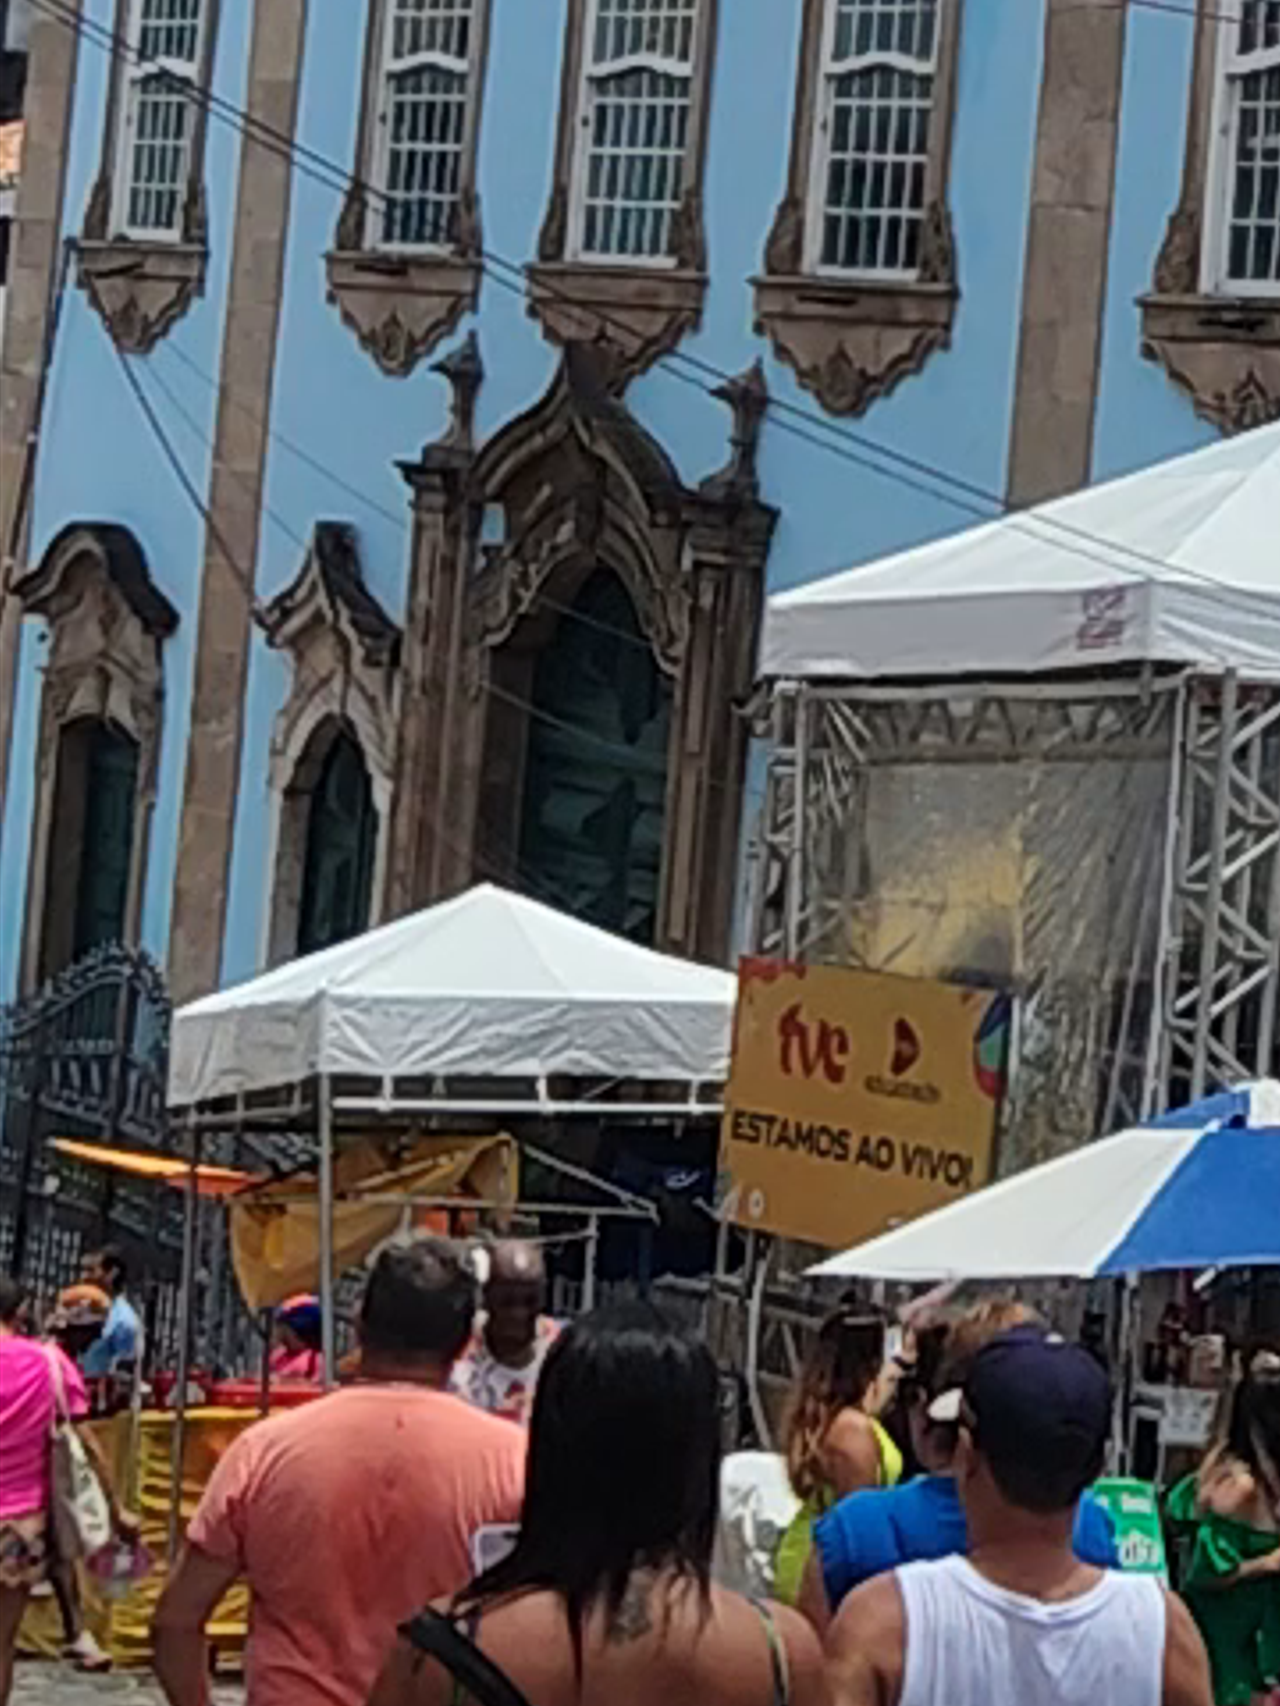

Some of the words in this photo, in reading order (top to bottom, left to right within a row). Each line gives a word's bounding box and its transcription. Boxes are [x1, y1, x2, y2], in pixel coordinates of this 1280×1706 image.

[731, 1110, 851, 1161] ESTAMOS
[855, 1136, 895, 1171] AO
[901, 1141, 973, 1189] VIVO!
